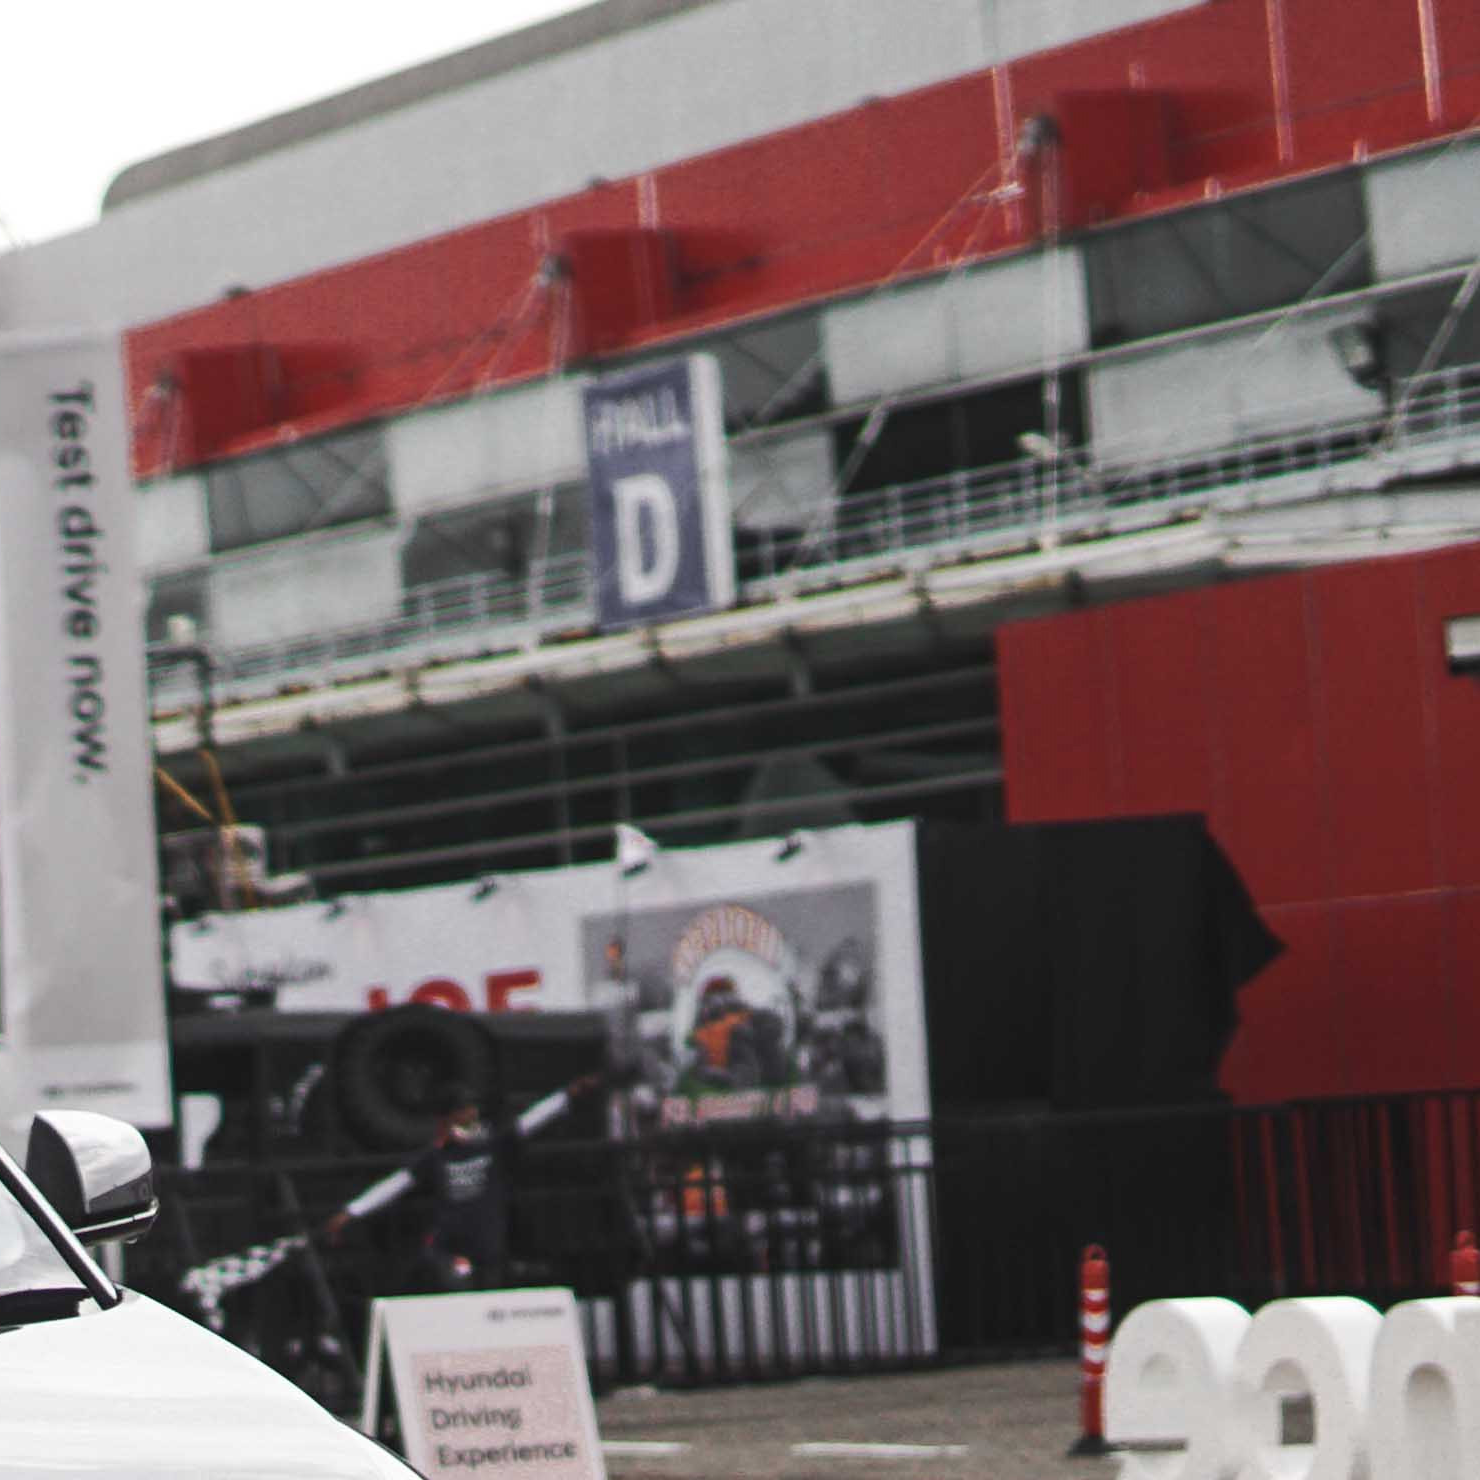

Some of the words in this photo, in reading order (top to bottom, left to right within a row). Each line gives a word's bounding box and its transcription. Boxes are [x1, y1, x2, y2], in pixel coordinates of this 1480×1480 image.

[47, 381, 96, 491] Test
[56, 504, 108, 640] drive
[612, 474, 681, 606] D
[424, 1362, 533, 1393] Hyundai
[430, 1405, 522, 1431] Driving
[437, 1440, 577, 1468] Experience
